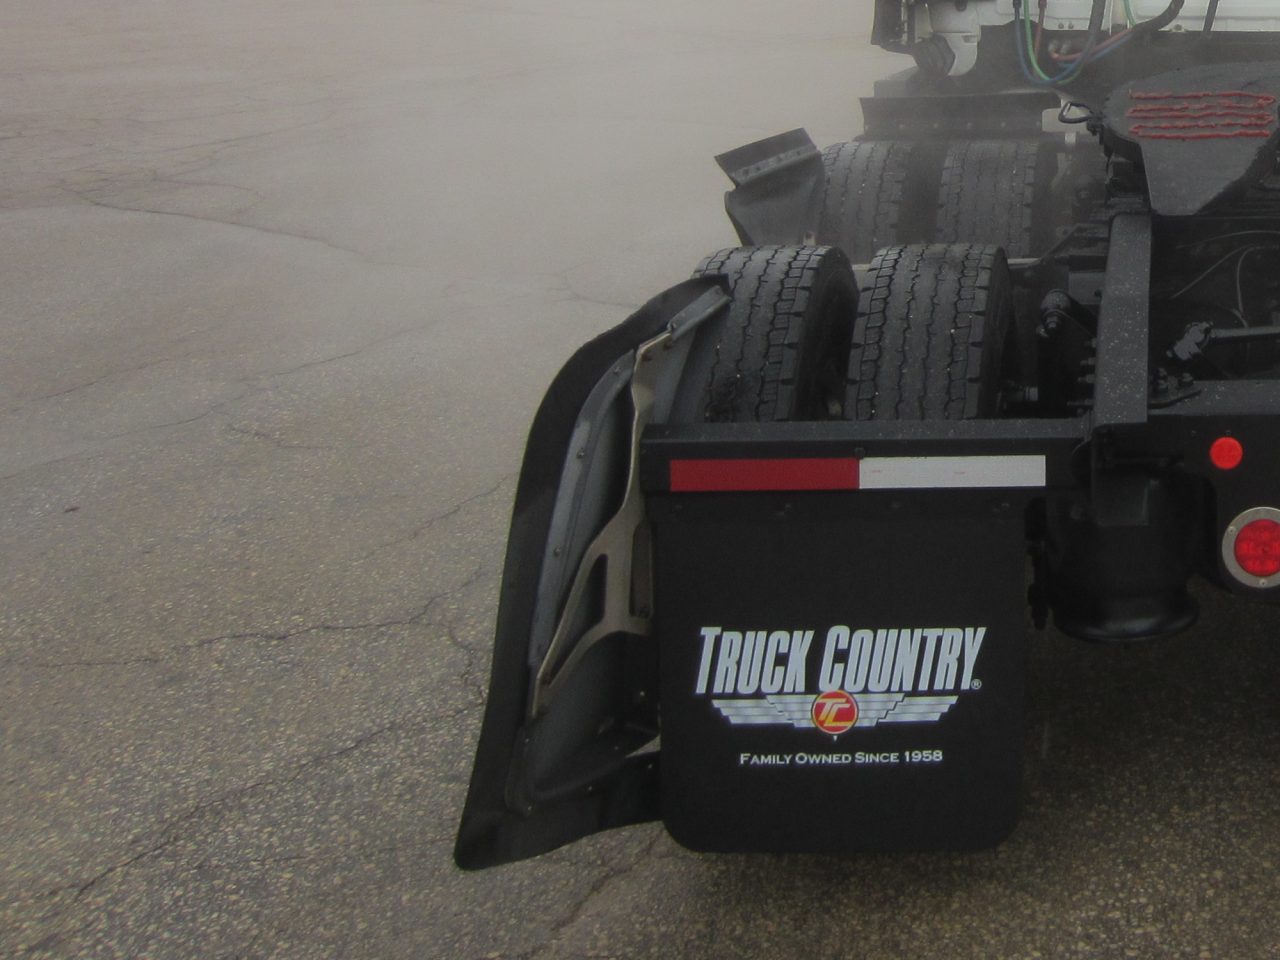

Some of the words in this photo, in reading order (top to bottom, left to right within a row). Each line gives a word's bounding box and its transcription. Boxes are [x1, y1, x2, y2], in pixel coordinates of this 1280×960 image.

[696, 626, 815, 694] TRUCK
[818, 624, 987, 692] COUNTRY
[739, 752, 793, 766] FAMILY
[794, 752, 853, 765] OWNED
[854, 751, 900, 764] SINCE
[903, 749, 944, 763] 1958
